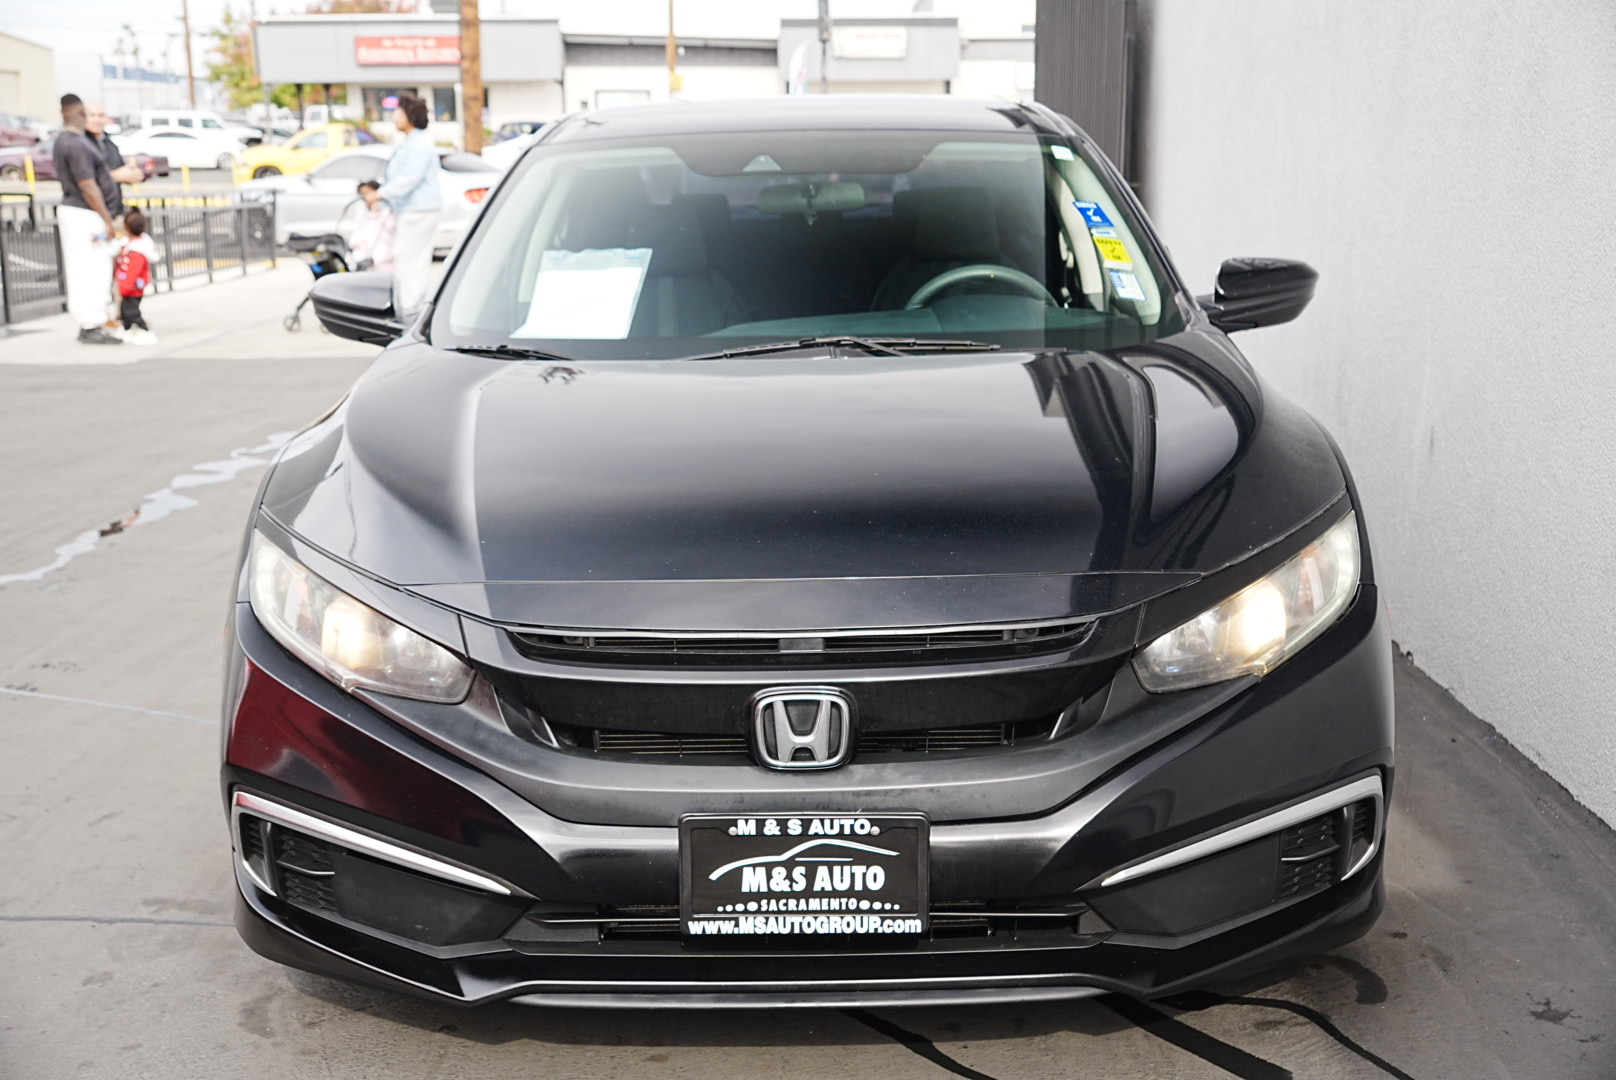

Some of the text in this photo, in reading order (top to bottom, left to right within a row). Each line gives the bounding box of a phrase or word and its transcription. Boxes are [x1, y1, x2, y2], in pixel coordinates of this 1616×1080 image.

[737, 818, 872, 836] M & S AUTO
[741, 865, 886, 893] M&S AUTO
[760, 897, 857, 911] SACRAMENTO
[688, 916, 922, 935] www.MSAUTOGROUP.com
